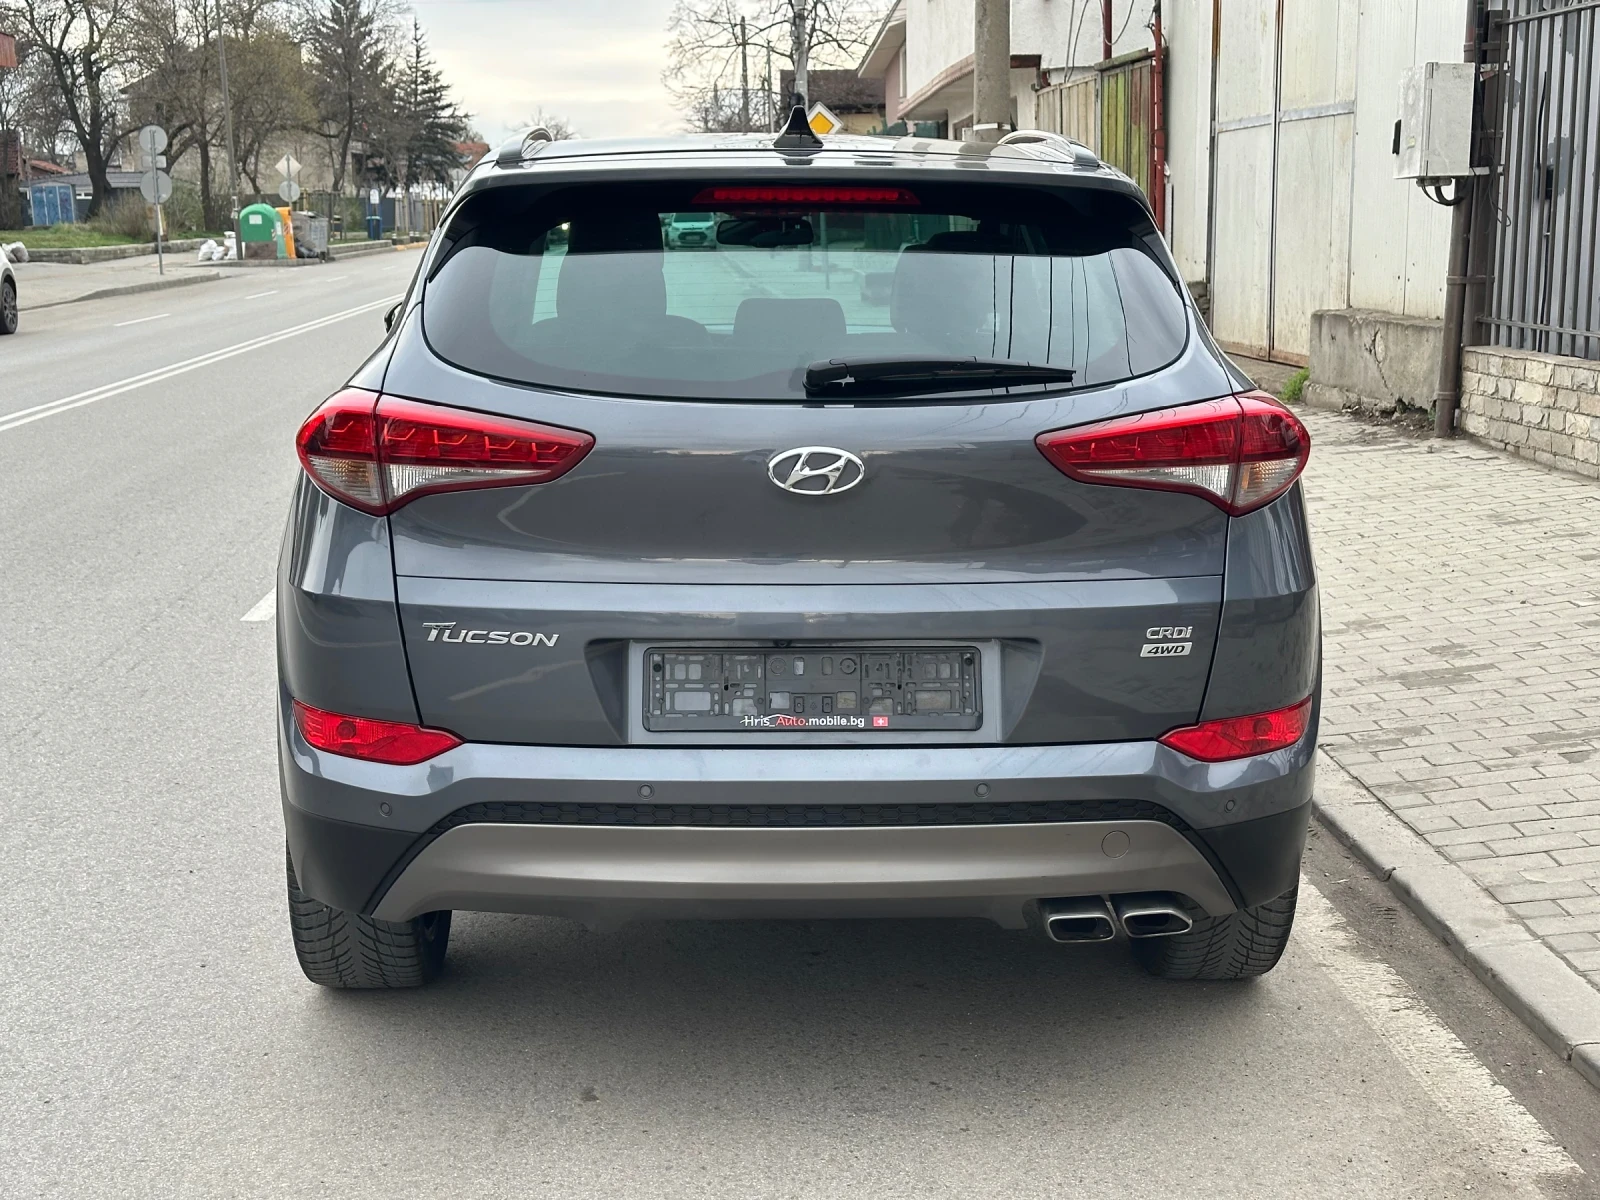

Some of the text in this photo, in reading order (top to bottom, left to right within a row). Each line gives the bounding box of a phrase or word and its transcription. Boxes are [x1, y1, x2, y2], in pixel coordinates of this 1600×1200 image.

[422, 622, 560, 647] TUCSON
[1146, 626, 1193, 639] CRDi
[1147, 645, 1185, 655] 4WD
